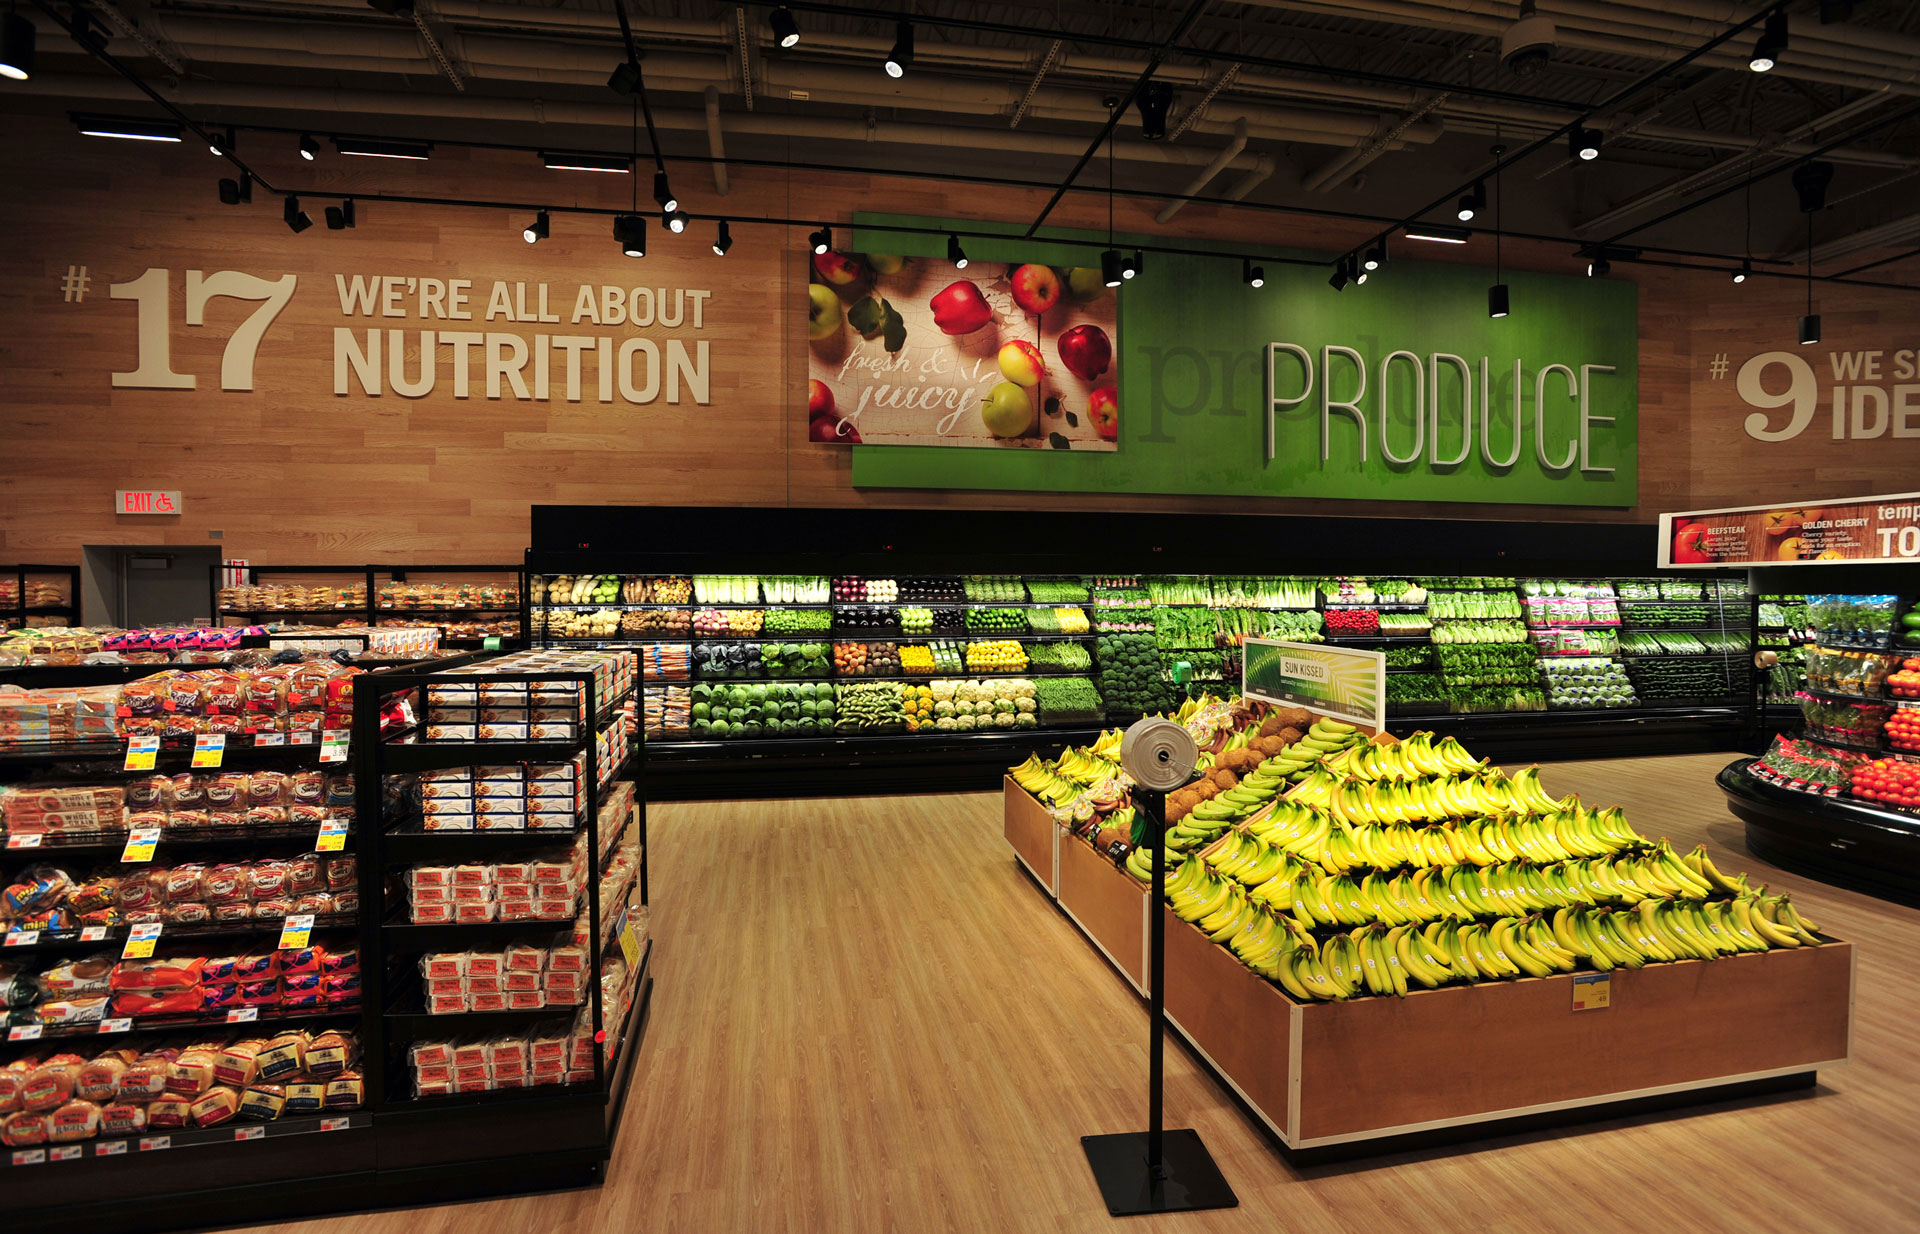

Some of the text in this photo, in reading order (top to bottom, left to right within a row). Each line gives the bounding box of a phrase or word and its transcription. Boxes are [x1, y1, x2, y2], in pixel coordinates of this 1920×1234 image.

[334, 273, 712, 329] WE'RE ALL ABOUT
[333, 327, 711, 405] NUTRITION
[837, 340, 947, 381] fresh &
[1830, 349, 1920, 381] WE S
[835, 372, 977, 438] juicy
[1264, 341, 1617, 473] PRODUCE
[124, 492, 153, 512] EXIT
[1707, 526, 1746, 535] BEEFSTEAK
[1802, 518, 1869, 530] GOLDEN CHERRY
[1876, 526, 1920, 557] TO
[1285, 661, 1324, 679] SUN KISSED
[61, 794, 91, 802] WHOLE
[65, 813, 96, 821] WHOLE
[23, 921, 48, 930] mini
